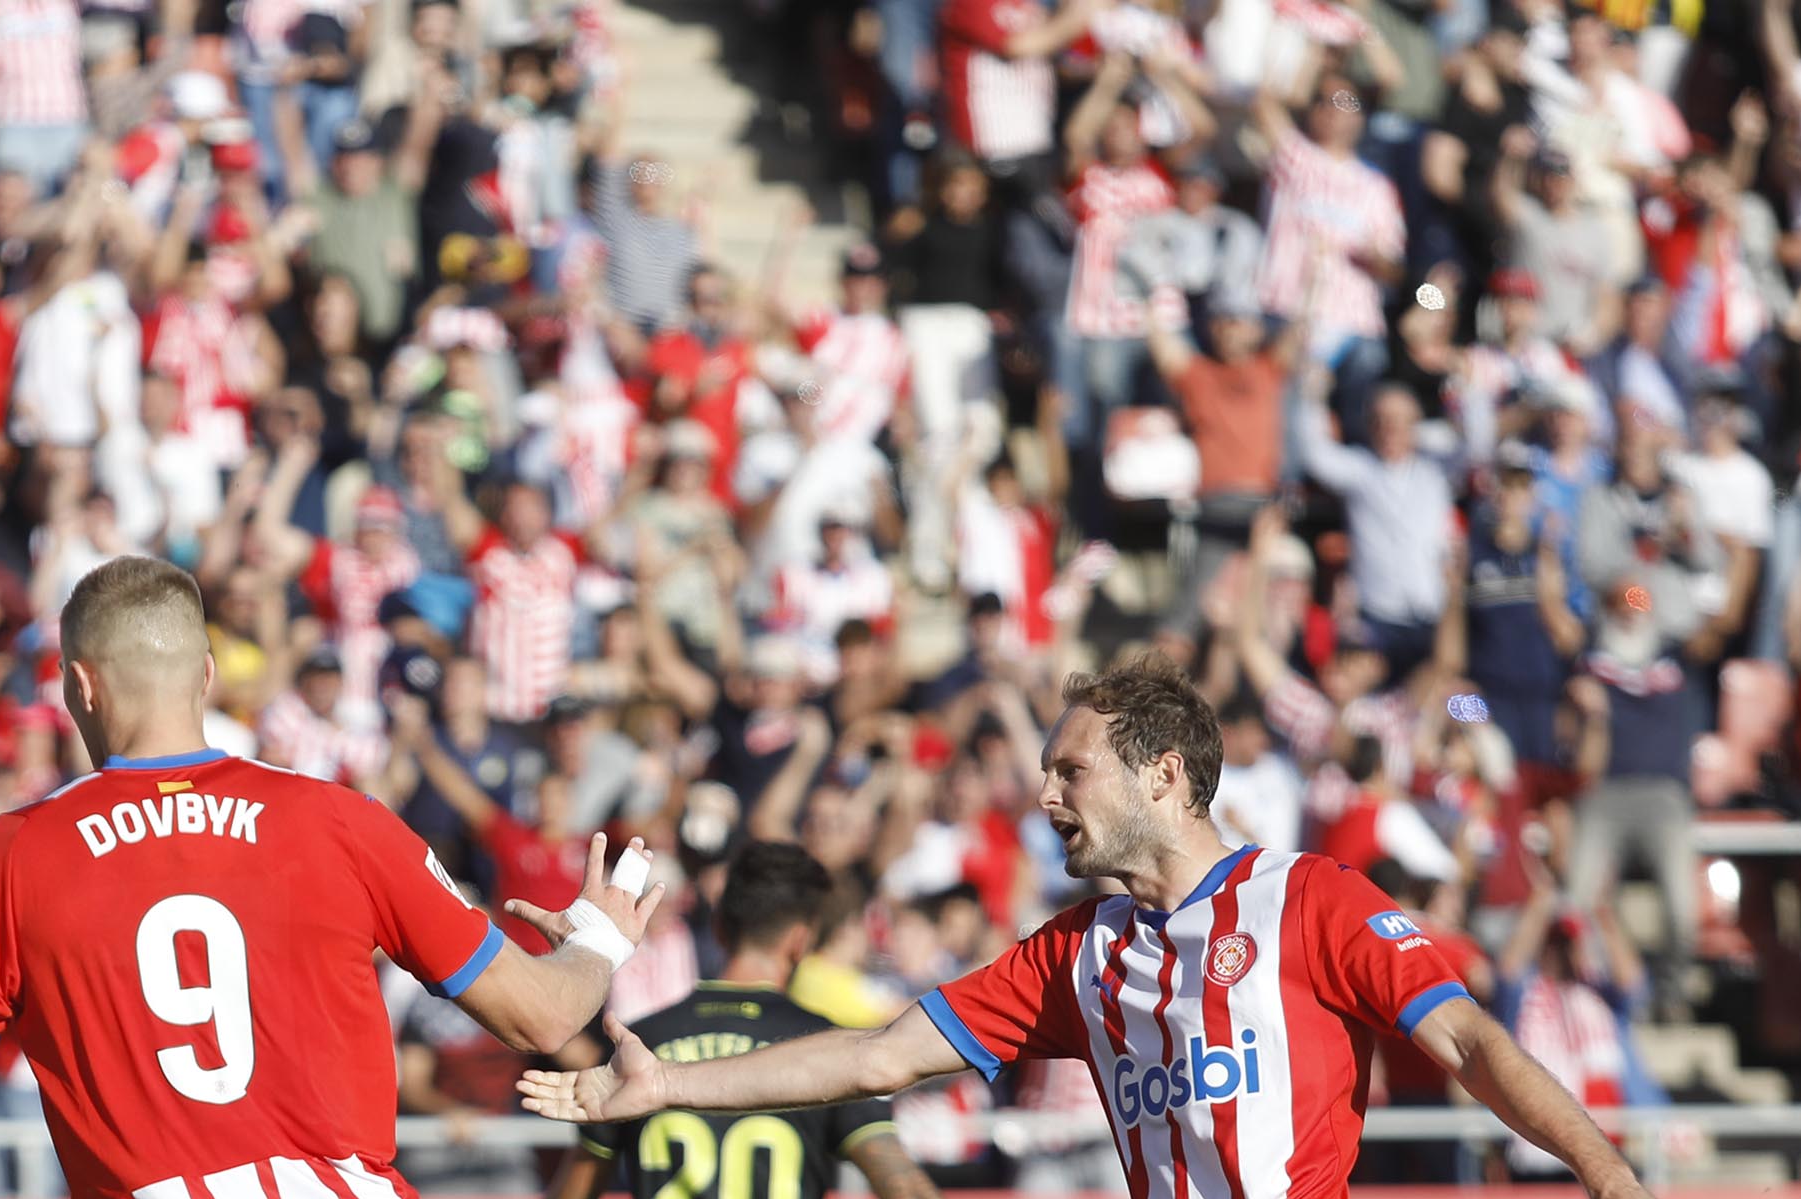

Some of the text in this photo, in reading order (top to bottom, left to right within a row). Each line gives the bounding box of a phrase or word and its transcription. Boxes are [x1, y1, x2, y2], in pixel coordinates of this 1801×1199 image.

[75, 792, 266, 859] DOVBYK
[135, 893, 256, 1105] 9
[1113, 1028, 1261, 1127] Gosbi
